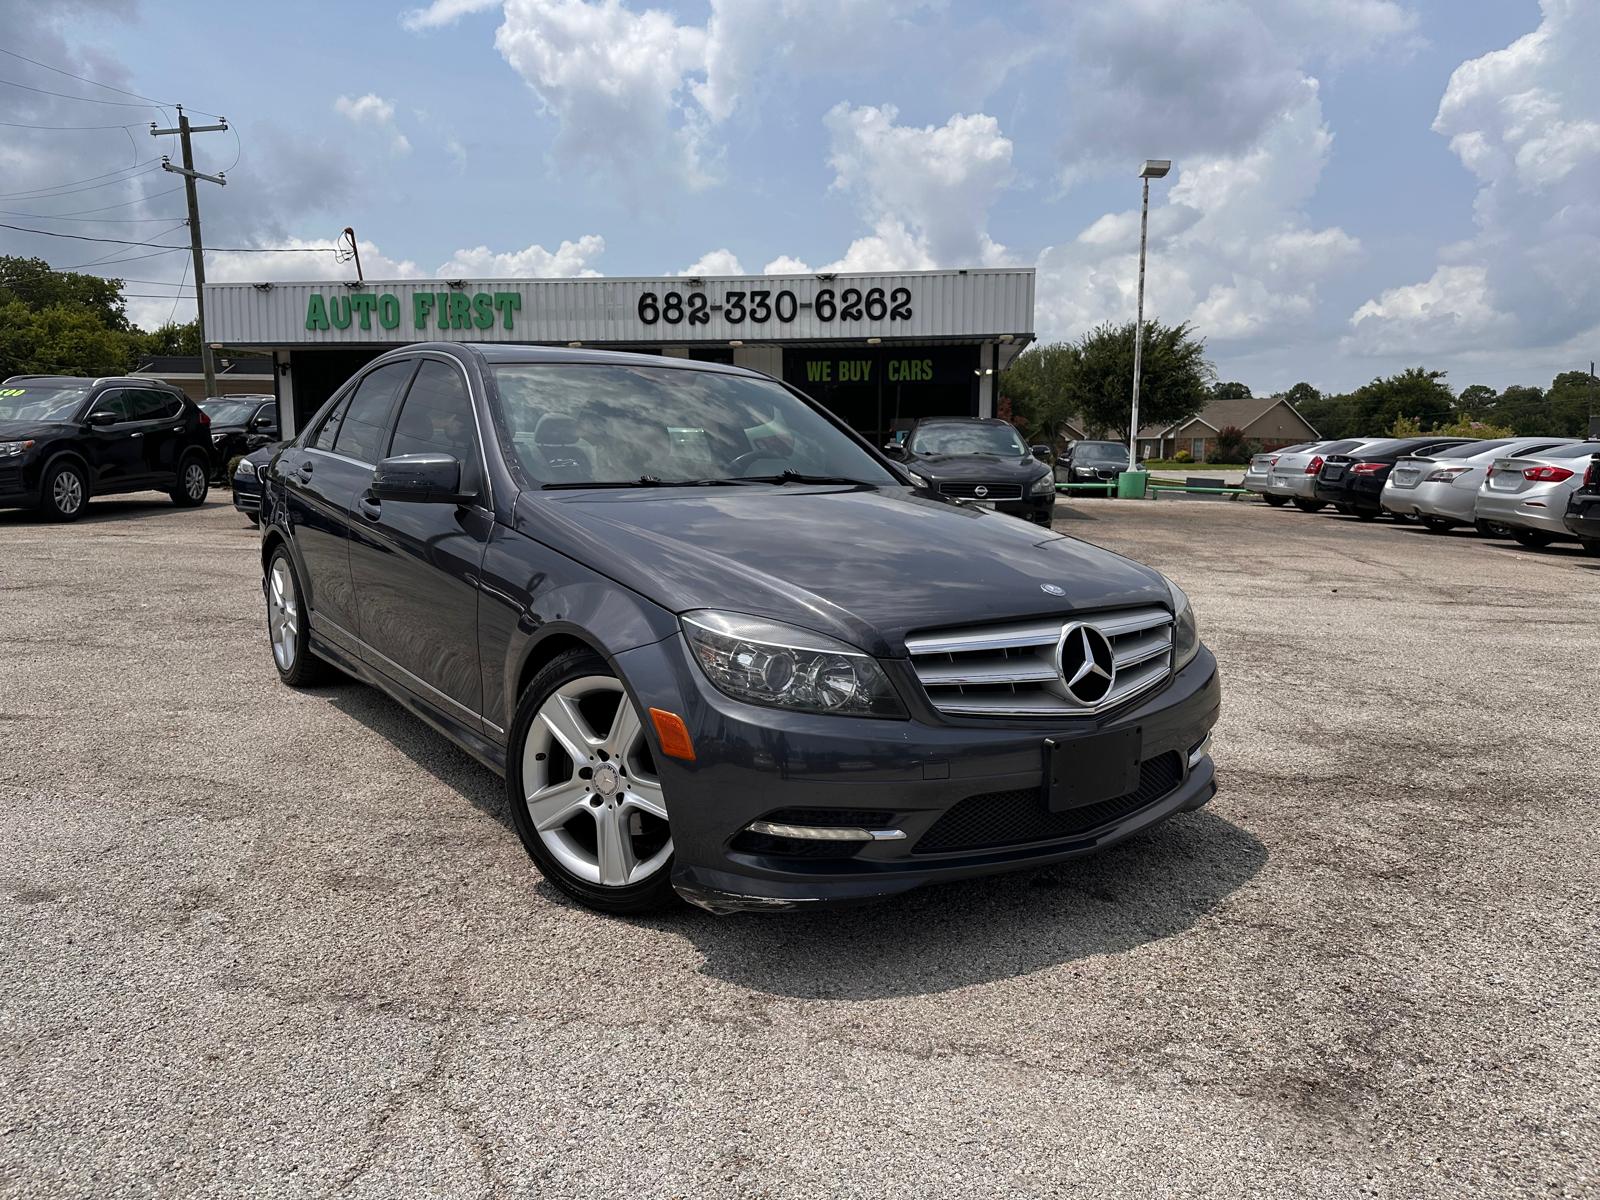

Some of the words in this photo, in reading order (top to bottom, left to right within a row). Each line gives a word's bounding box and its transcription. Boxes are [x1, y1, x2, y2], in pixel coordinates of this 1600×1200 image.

[305, 293, 400, 331] AUTO
[412, 291, 522, 330] FIRST
[637, 287, 913, 326] 682-330-6262
[806, 361, 832, 381] WE
[839, 360, 872, 381] BUY
[888, 359, 933, 381] CARS
